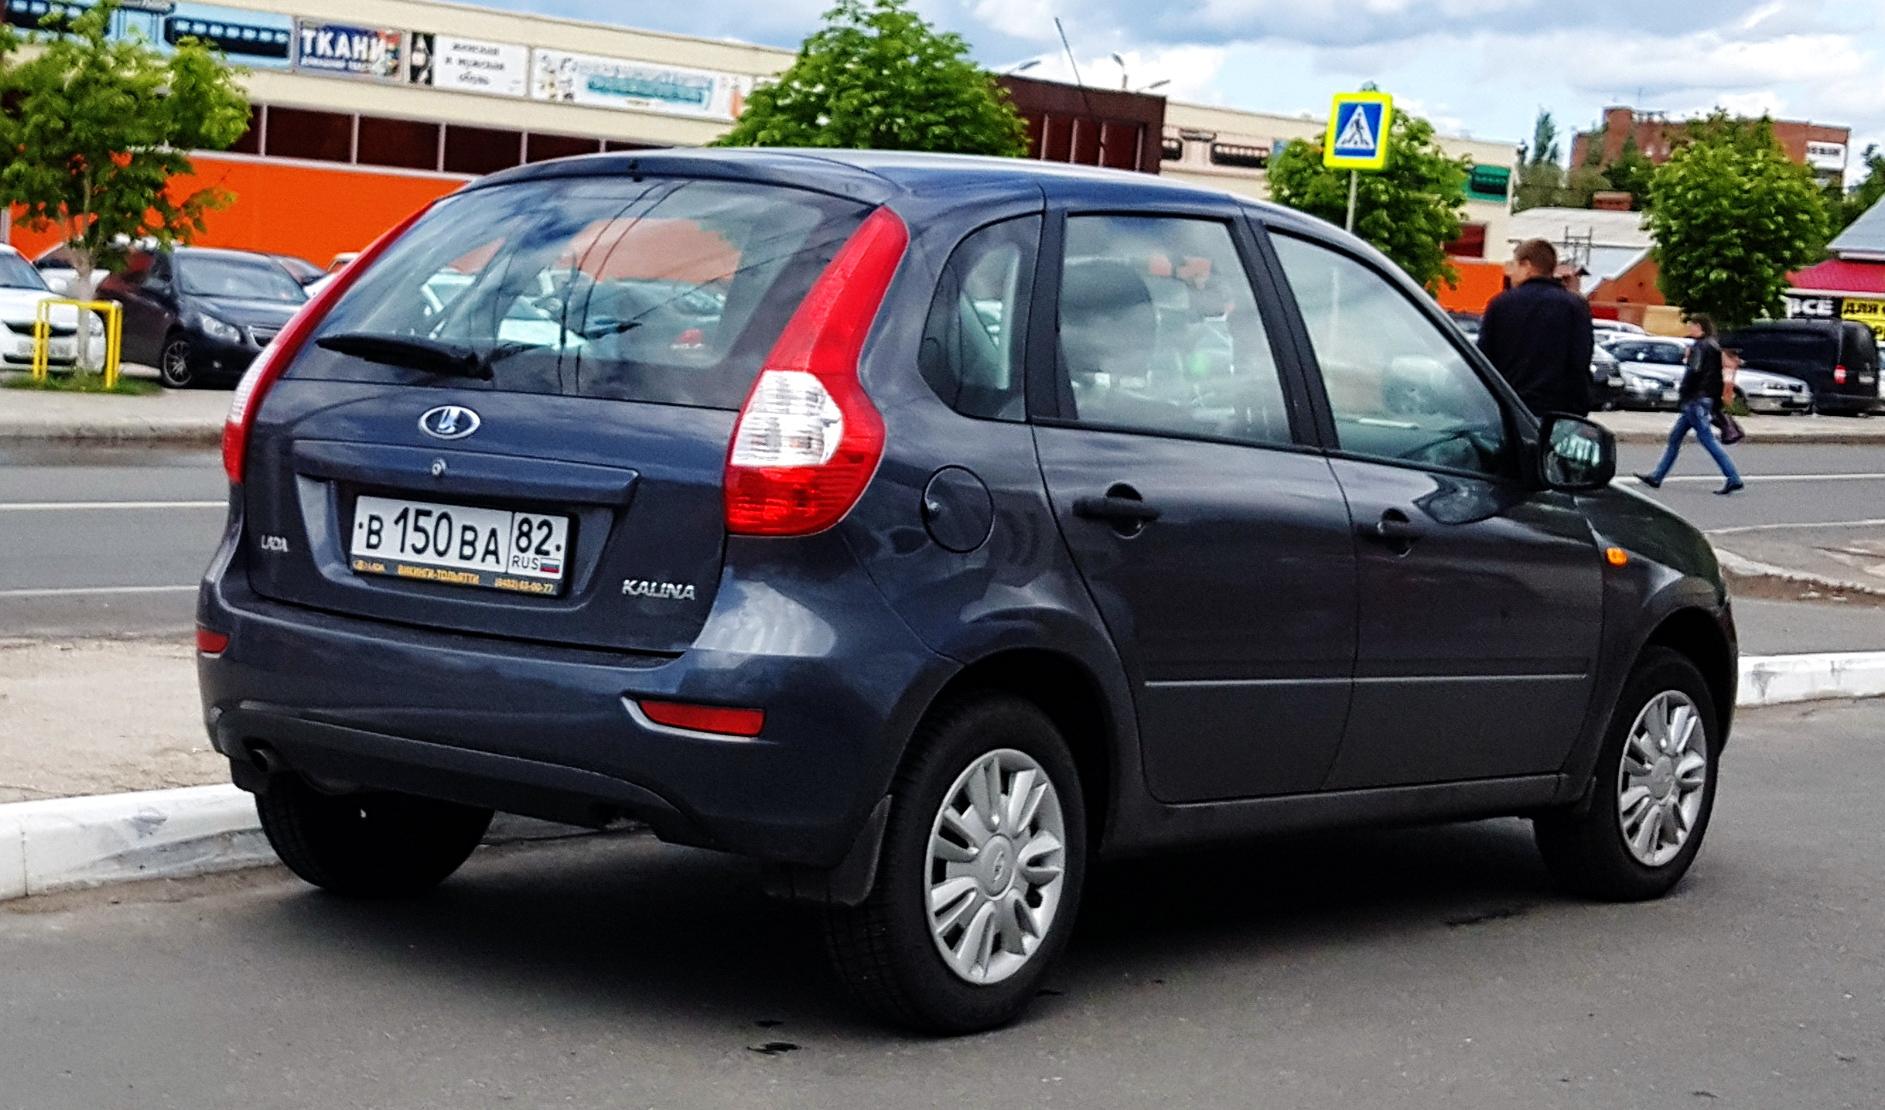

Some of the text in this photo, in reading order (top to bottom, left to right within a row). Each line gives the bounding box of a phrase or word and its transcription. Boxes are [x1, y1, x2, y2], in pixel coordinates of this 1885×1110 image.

[302, 29, 386, 62] ТКАНИ
[515, 517, 553, 556] 82
[511, 555, 540, 570] RUS
[622, 579, 696, 600] KALINA
